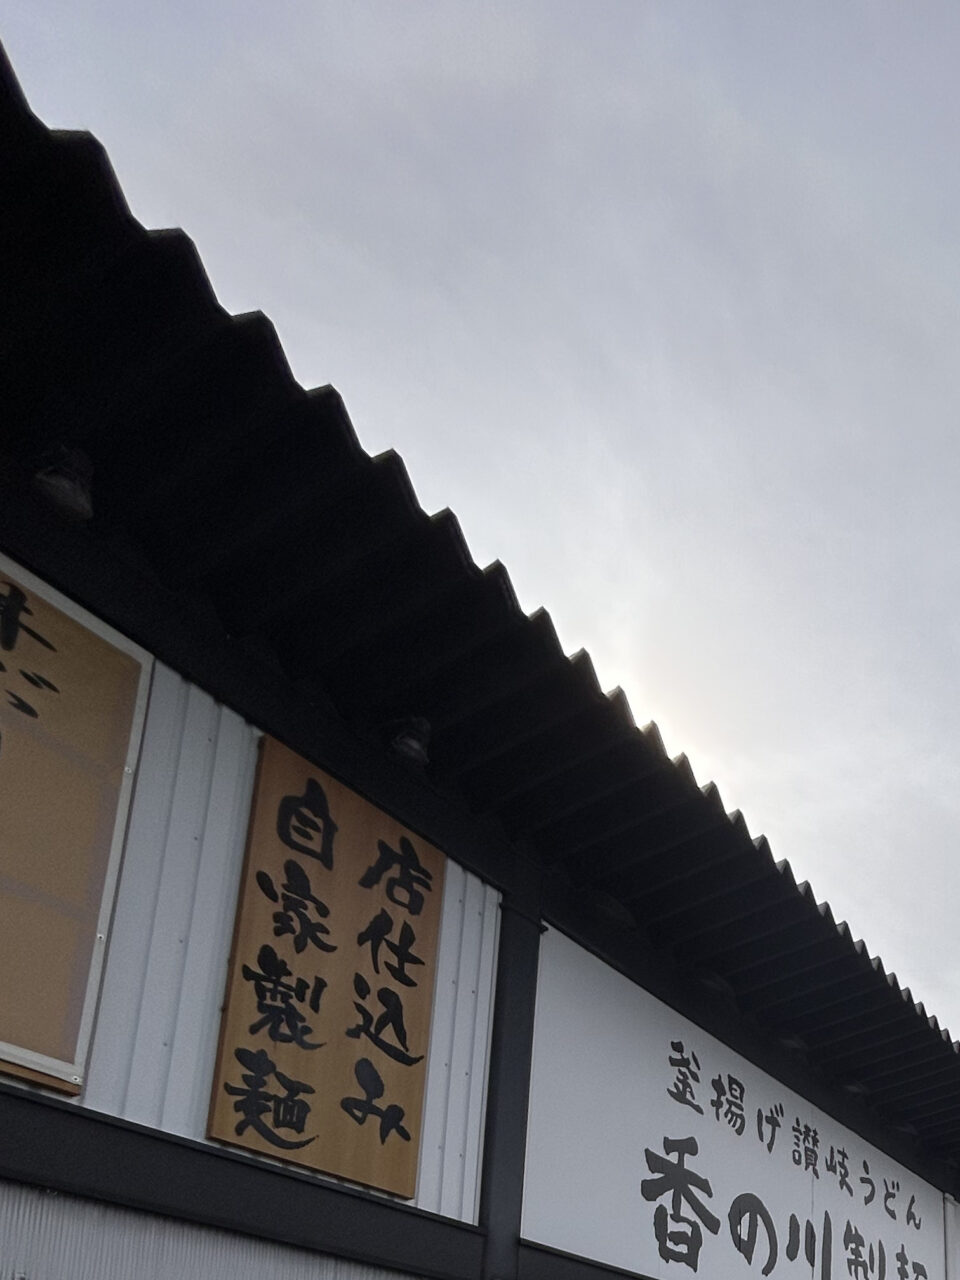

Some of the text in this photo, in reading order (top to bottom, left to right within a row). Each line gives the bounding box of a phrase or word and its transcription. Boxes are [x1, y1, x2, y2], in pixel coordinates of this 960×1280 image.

[224, 777, 337, 1150] 自家製麺
[341, 834, 434, 1146] 店仕込み
[667, 1039, 922, 1231] 釜揚げ讃岐うどん
